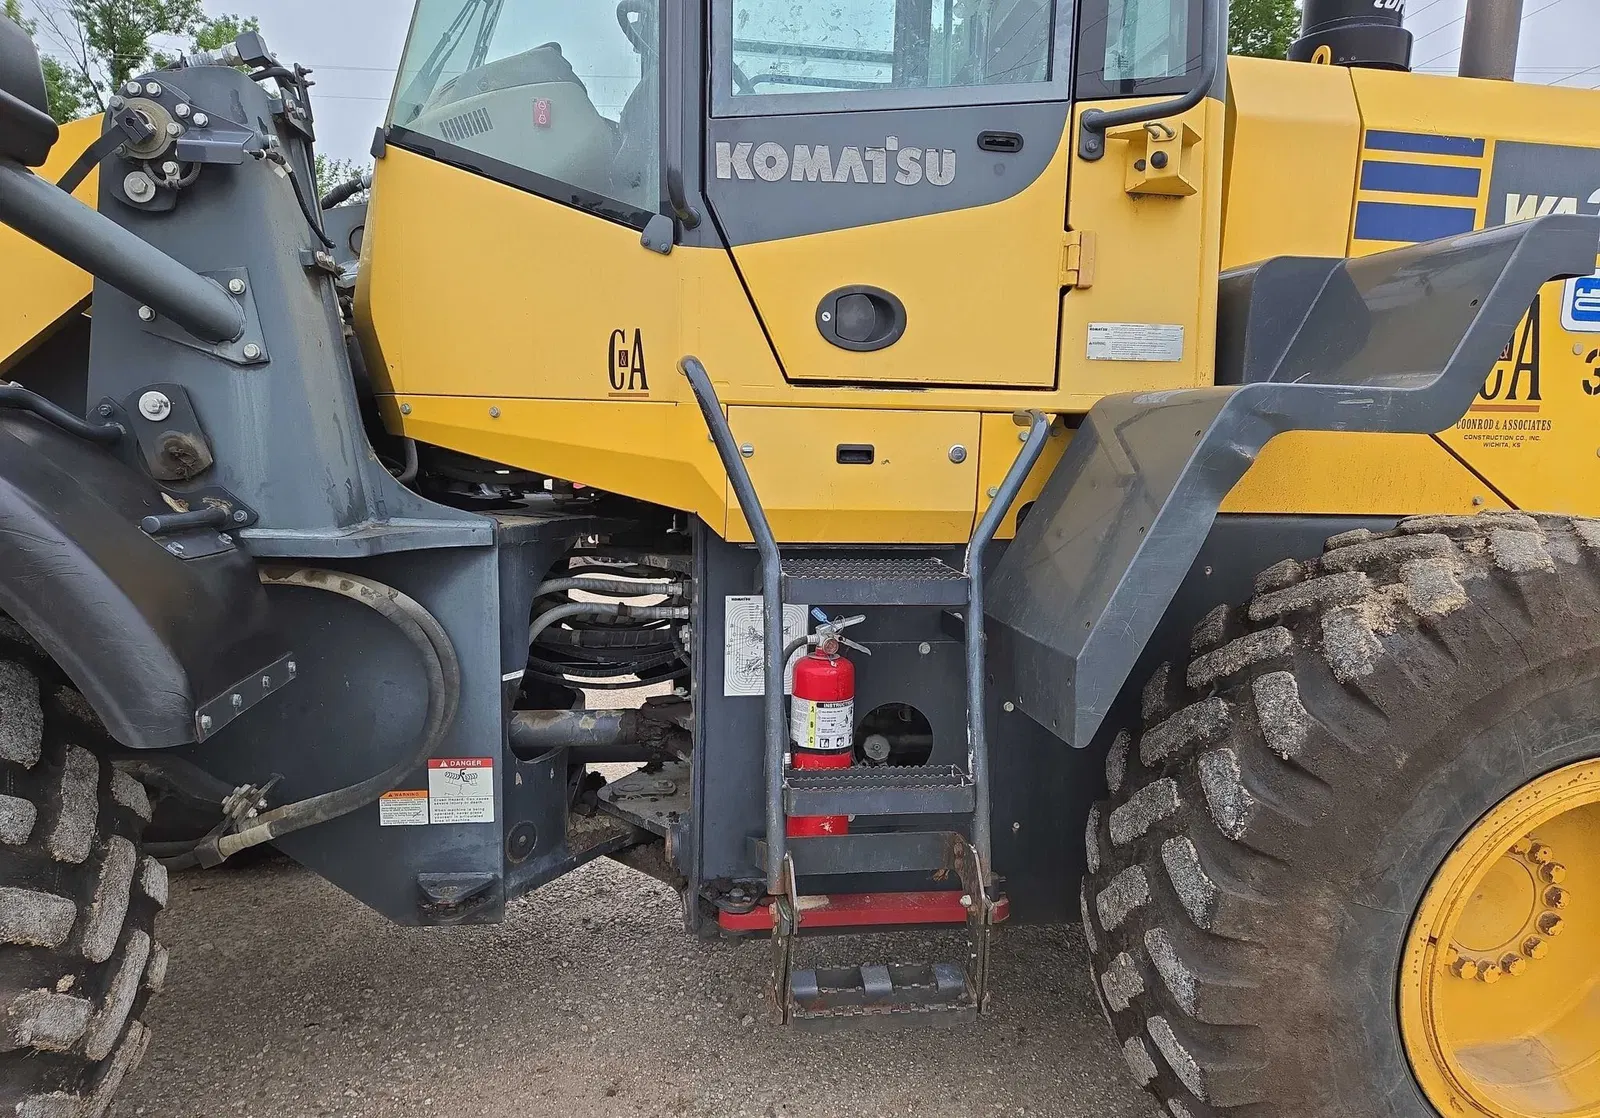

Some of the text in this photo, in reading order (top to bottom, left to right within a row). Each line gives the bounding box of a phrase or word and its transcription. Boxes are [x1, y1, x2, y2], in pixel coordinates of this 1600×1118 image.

[715, 135, 956, 186] KOMATSU
[1456, 418, 1552, 431] COONROD & ASSOCIATES
